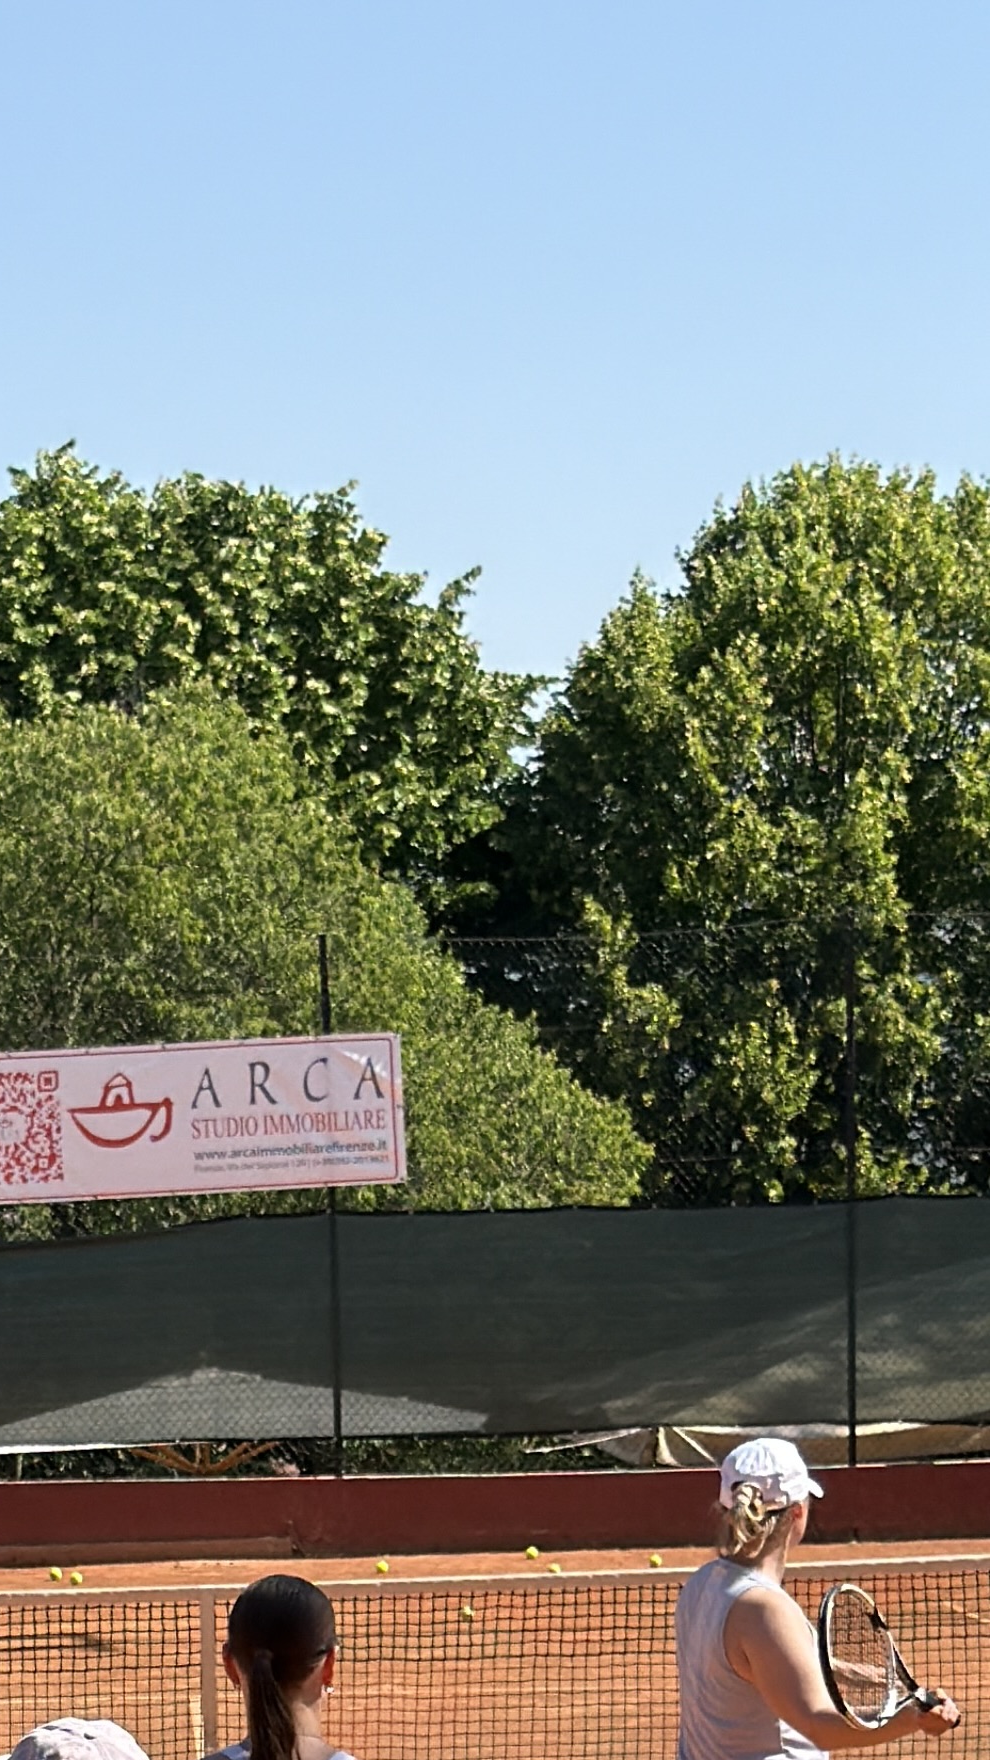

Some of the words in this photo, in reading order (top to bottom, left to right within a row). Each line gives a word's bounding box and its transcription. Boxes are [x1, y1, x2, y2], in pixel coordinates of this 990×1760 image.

[191, 1057, 385, 1109] ARCA
[191, 1116, 258, 1139] STUDIO
[263, 1110, 386, 1135] IMMOBILIARE
[194, 1139, 388, 1160] www.arcaimmobiliarefirenze.it
